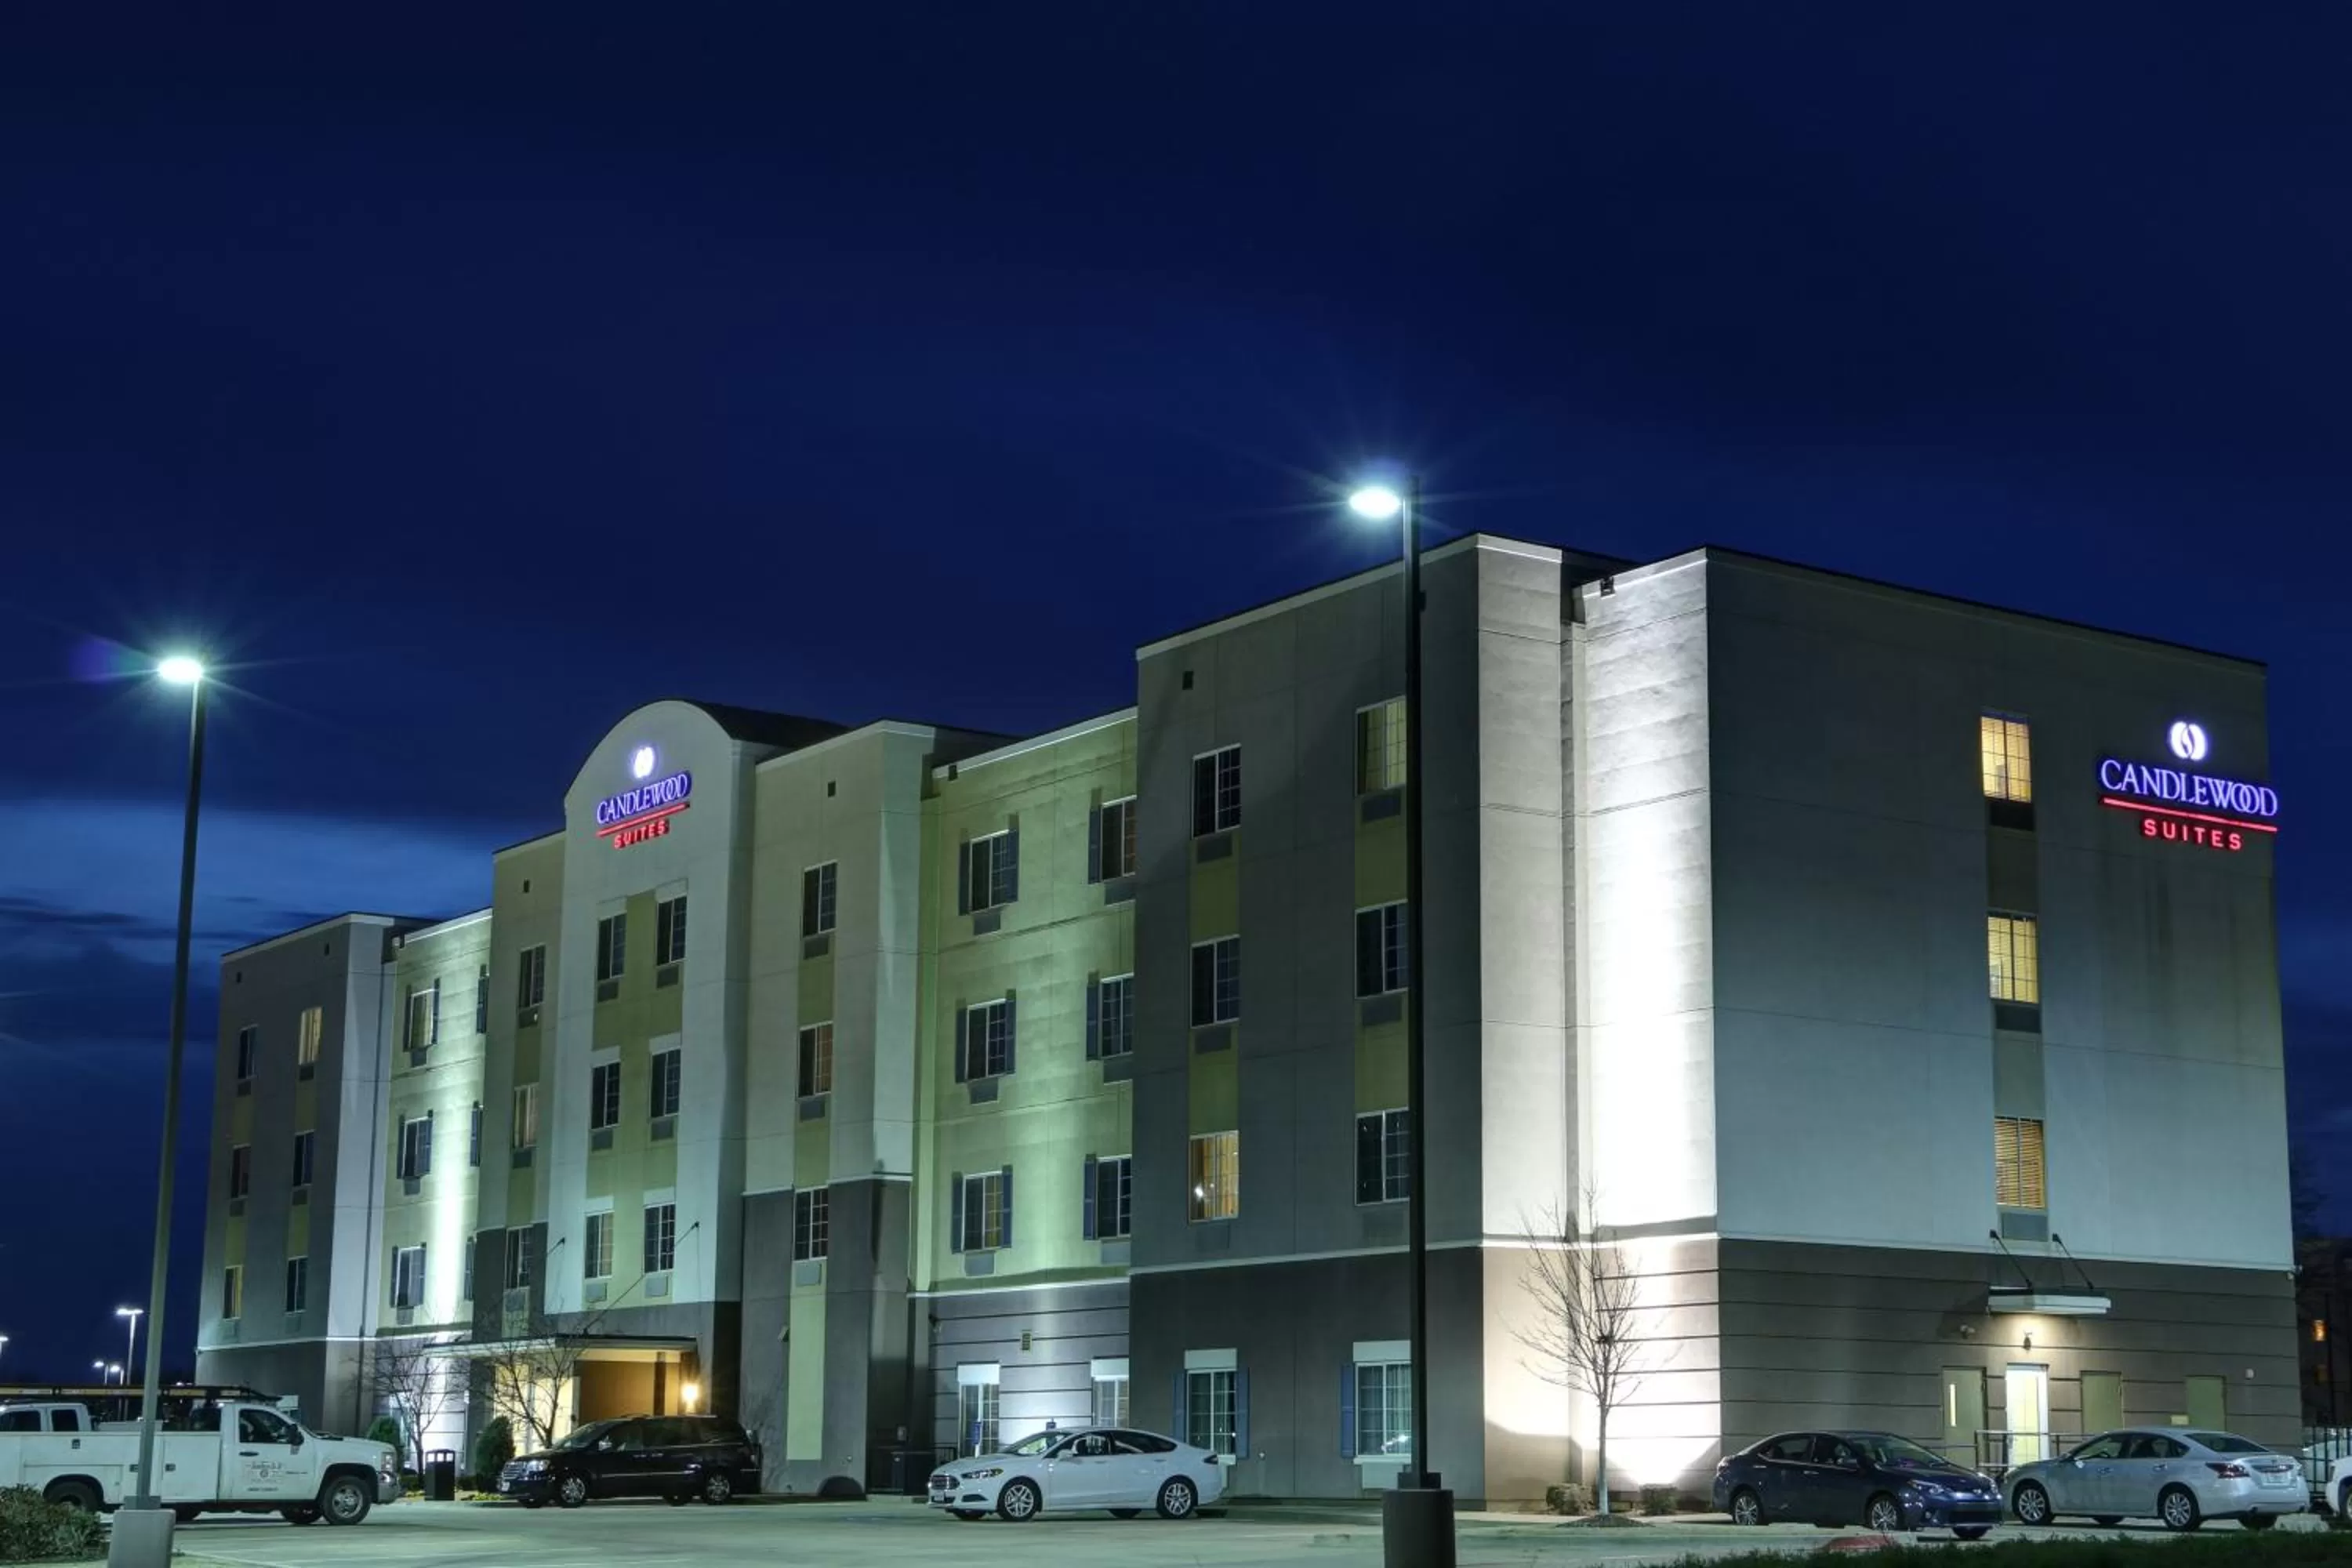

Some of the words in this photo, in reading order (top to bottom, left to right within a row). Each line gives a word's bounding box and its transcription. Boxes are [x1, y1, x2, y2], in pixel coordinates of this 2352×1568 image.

[596, 771, 690, 825] CANDLEWOOD
[2100, 759, 2279, 818] CANDLEWOOD
[613, 819, 668, 849] SUITES
[2143, 818, 2243, 851] SUITES
